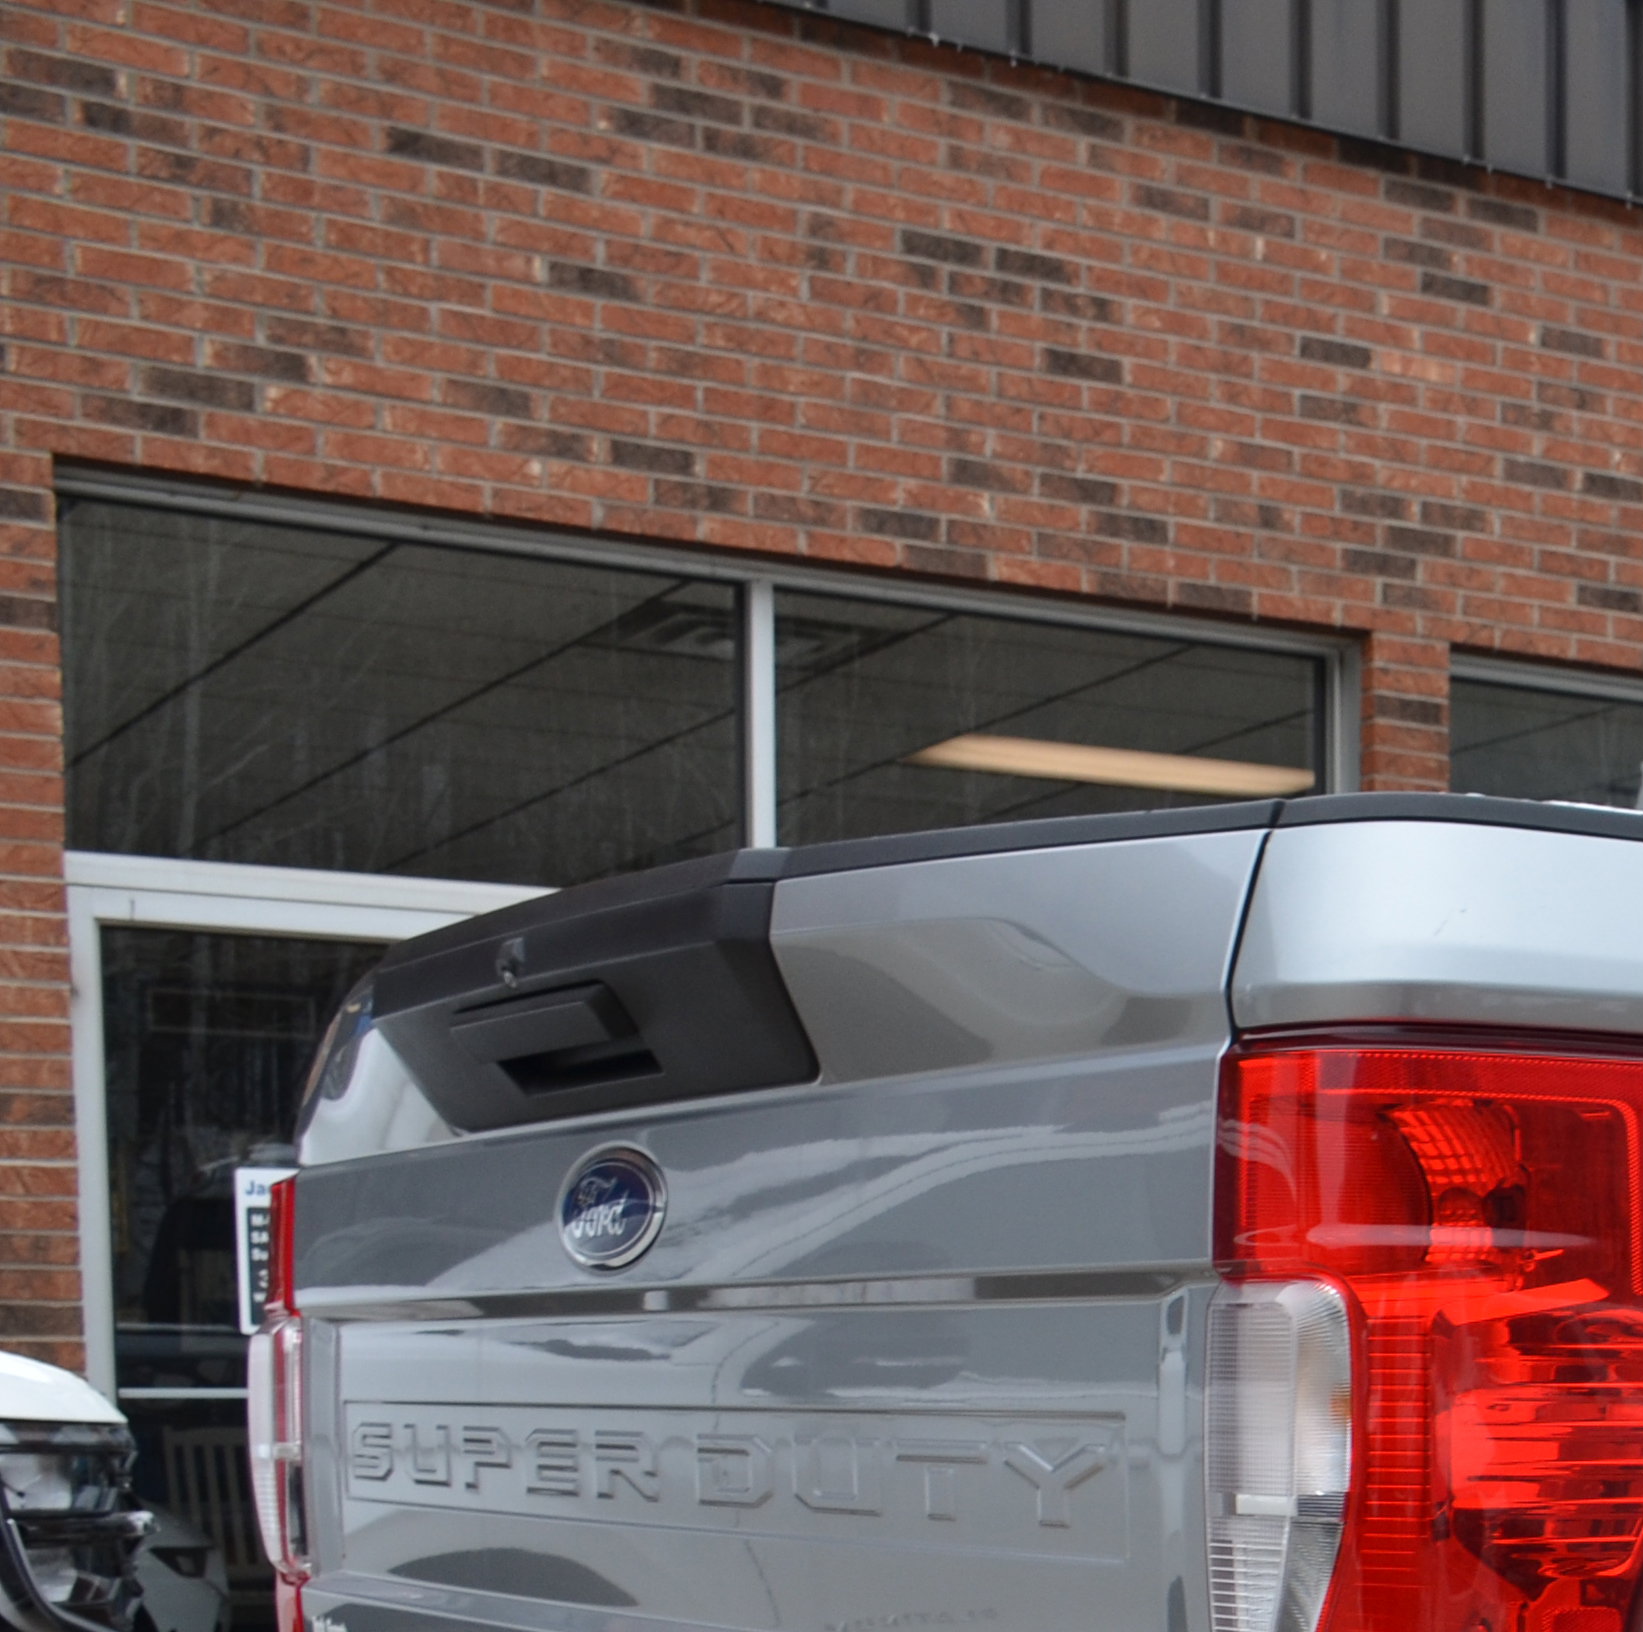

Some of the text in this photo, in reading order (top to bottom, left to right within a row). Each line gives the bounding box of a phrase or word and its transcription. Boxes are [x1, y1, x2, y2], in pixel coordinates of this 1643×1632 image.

[572, 1176, 631, 1240] Ford
[350, 1421, 1113, 1529] SUPER DUTY
